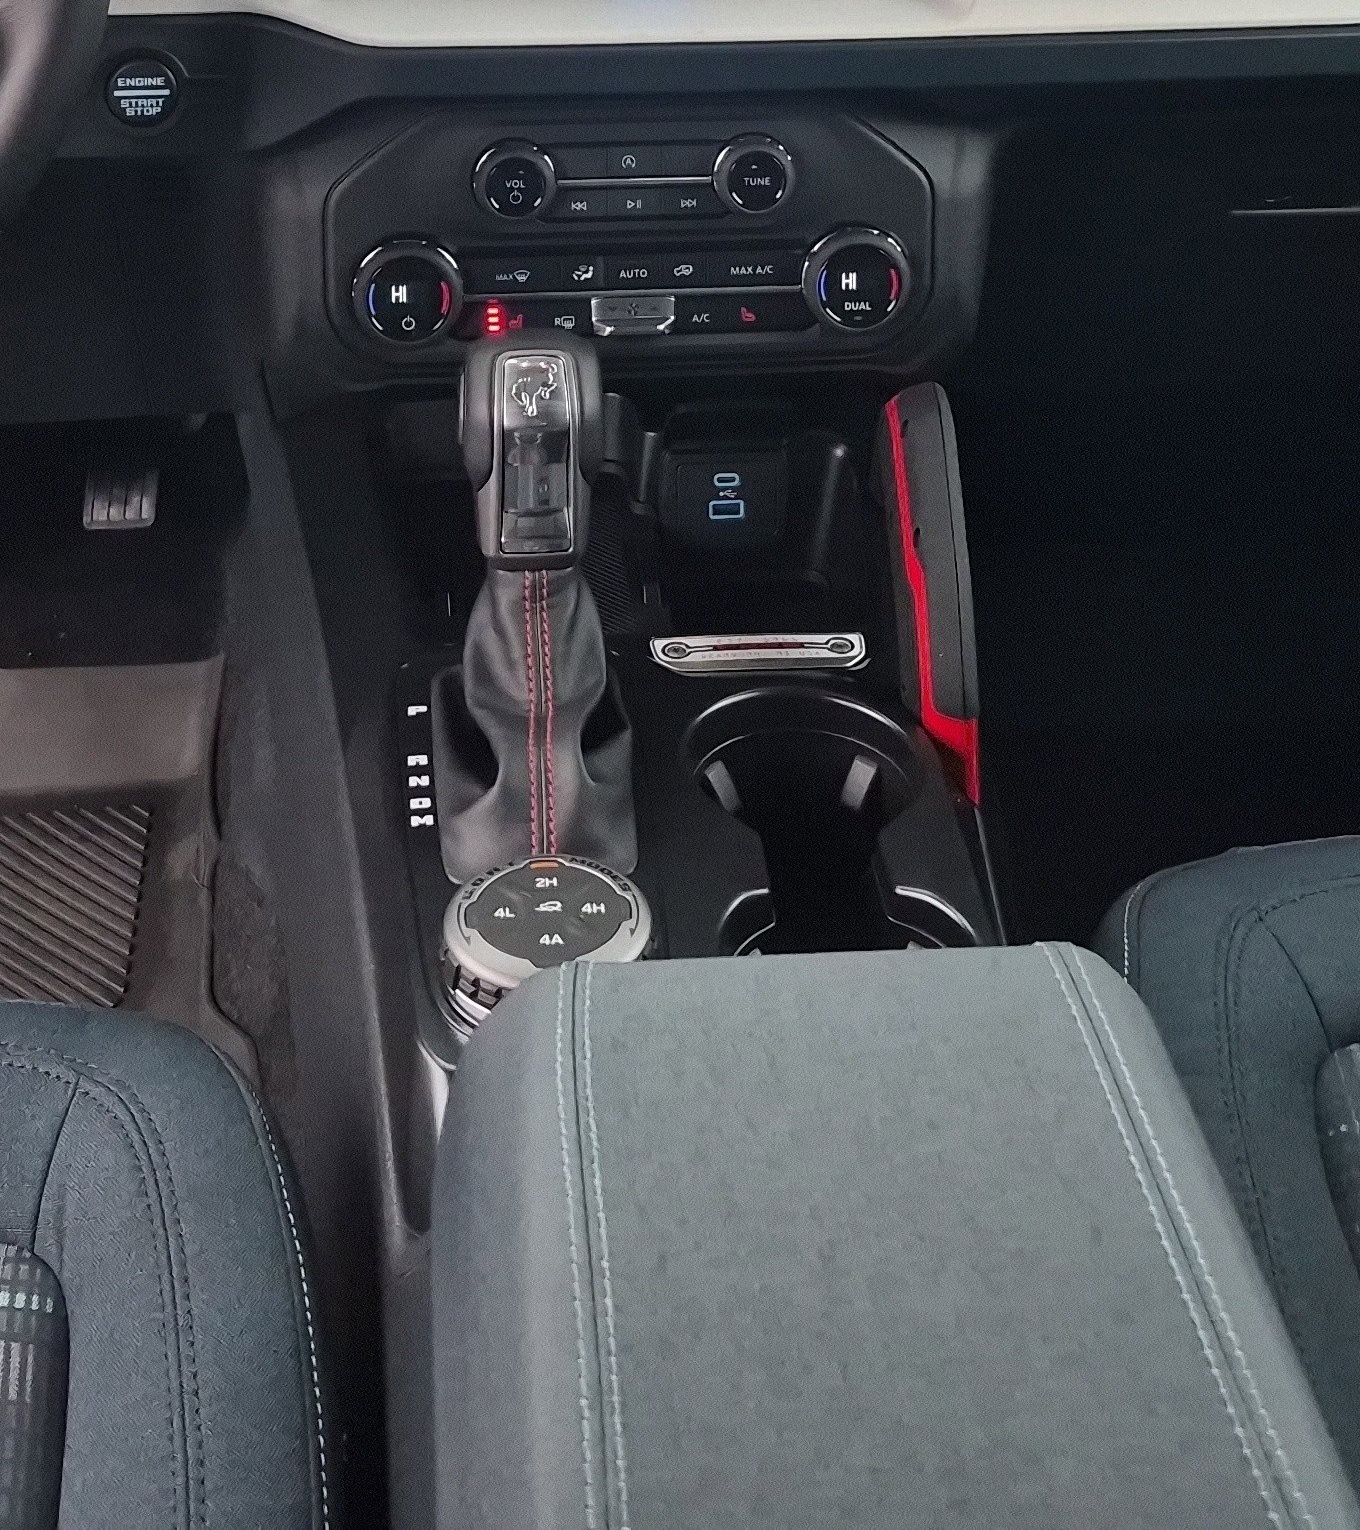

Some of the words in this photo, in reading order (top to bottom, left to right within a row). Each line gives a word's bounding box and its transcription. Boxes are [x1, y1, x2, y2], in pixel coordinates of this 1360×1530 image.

[117, 76, 166, 87] ENGINE
[120, 97, 165, 109] START
[125, 106, 163, 118] STOP
[505, 179, 526, 188] VOL
[743, 176, 771, 186] TUNE
[618, 268, 648, 279] AUTO
[730, 265, 753, 275] MAX
[755, 264, 774, 275] A/C
[841, 272, 857, 290] HI
[390, 285, 407, 304] HI
[844, 300, 872, 311] DUAL
[692, 312, 710, 323] A/C
[407, 705, 428, 717] P
[408, 775, 430, 787] N
[410, 814, 434, 827] M
[568, 856, 632, 893] MODES
[534, 877, 558, 888] 2H
[493, 906, 516, 919] 4L
[580, 902, 606, 914] 4H
[539, 933, 565, 946] 4A
